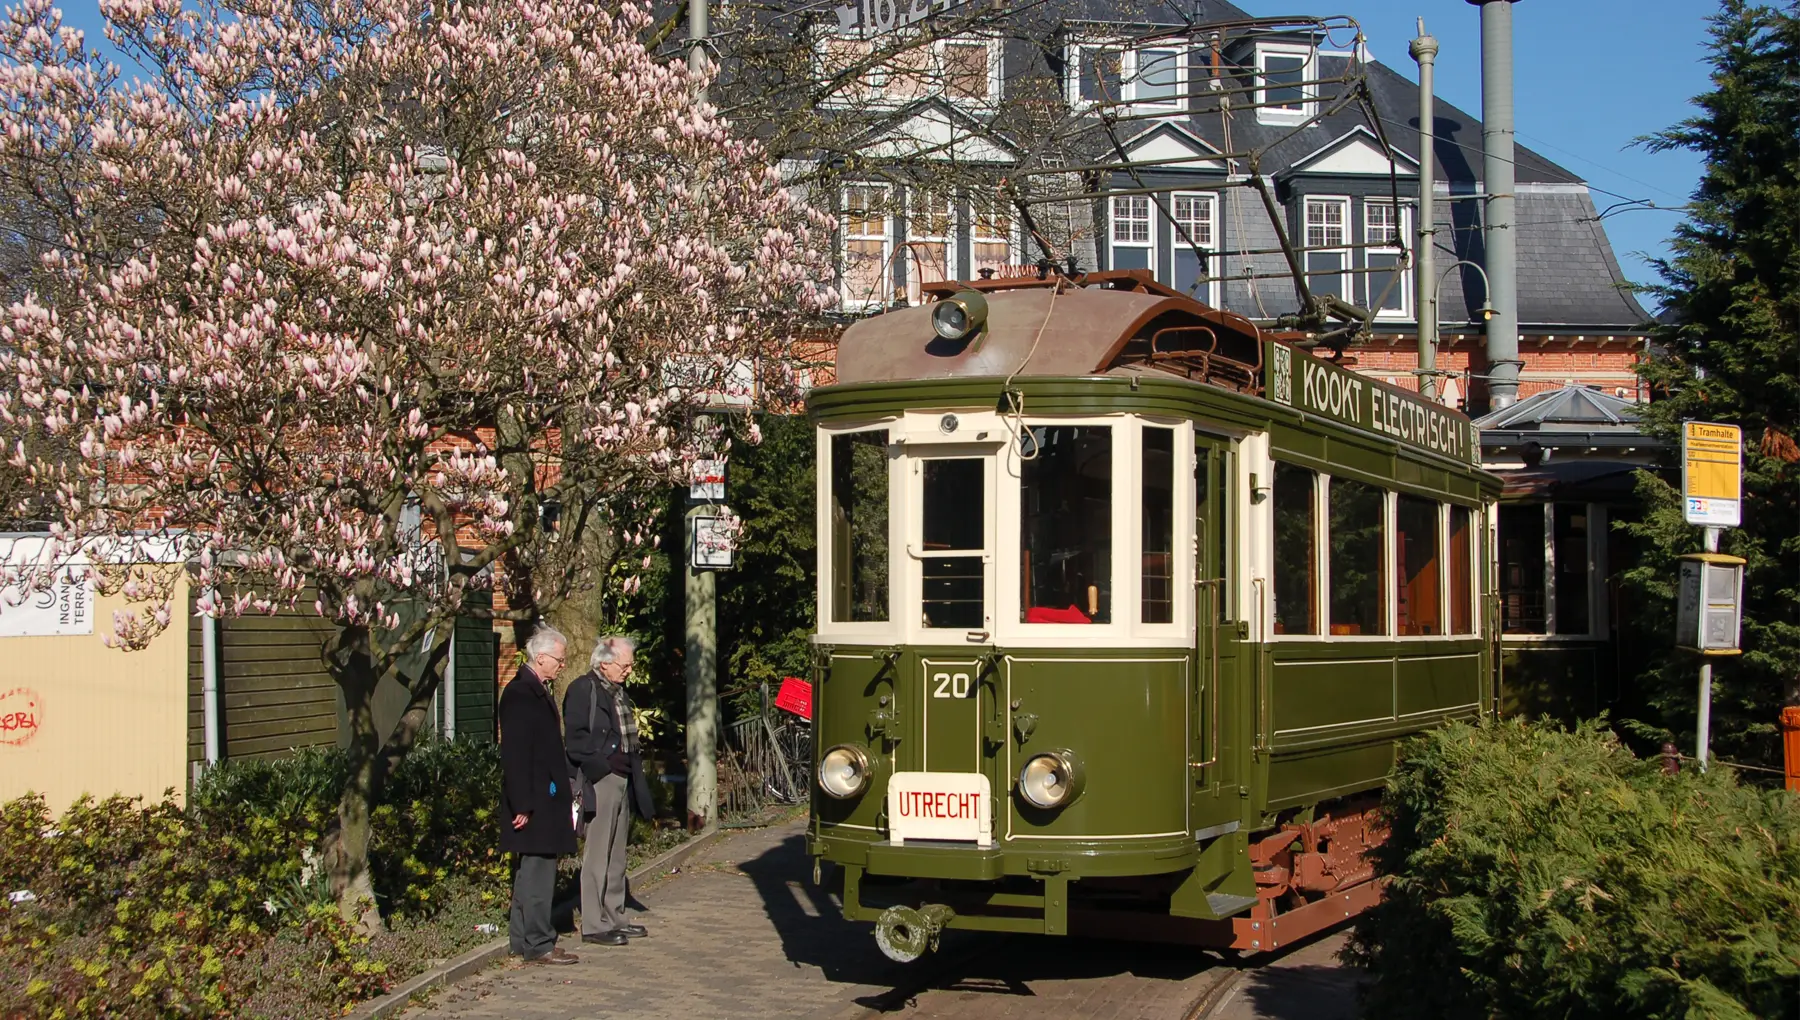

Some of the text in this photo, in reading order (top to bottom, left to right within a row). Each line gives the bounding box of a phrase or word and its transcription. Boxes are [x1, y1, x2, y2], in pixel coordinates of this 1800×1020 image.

[1303, 359, 1362, 423] KOOKT
[1698, 426, 1734, 439] Tramhalte
[74, 574, 86, 626] TERRAS
[933, 673, 970, 699] 20
[899, 791, 980, 819] UTRECHT
